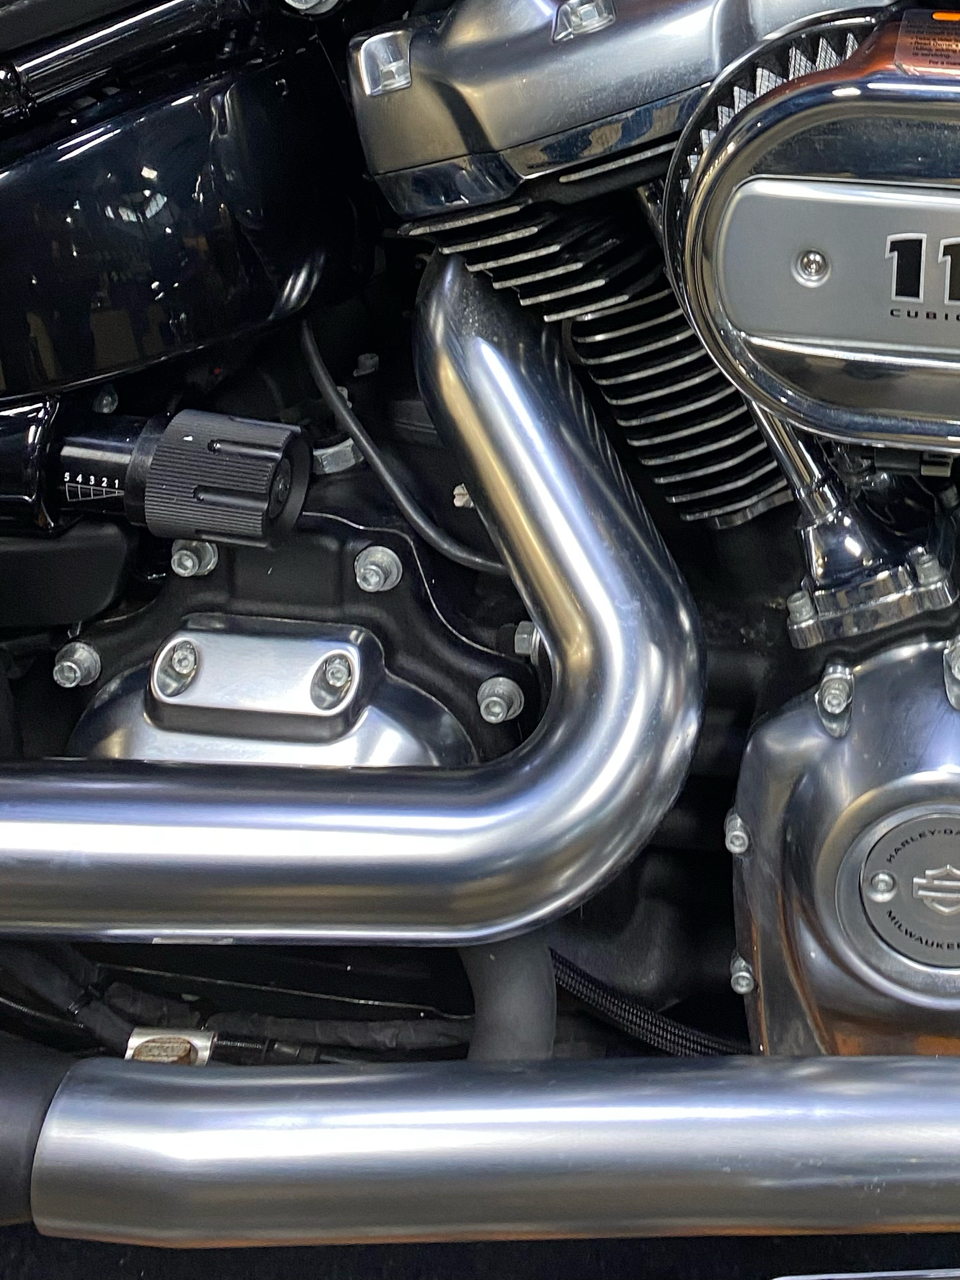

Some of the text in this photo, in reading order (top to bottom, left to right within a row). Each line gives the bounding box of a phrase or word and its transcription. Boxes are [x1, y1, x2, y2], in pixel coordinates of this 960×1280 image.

[64, 471, 119, 489] 5 4 3 2 1
